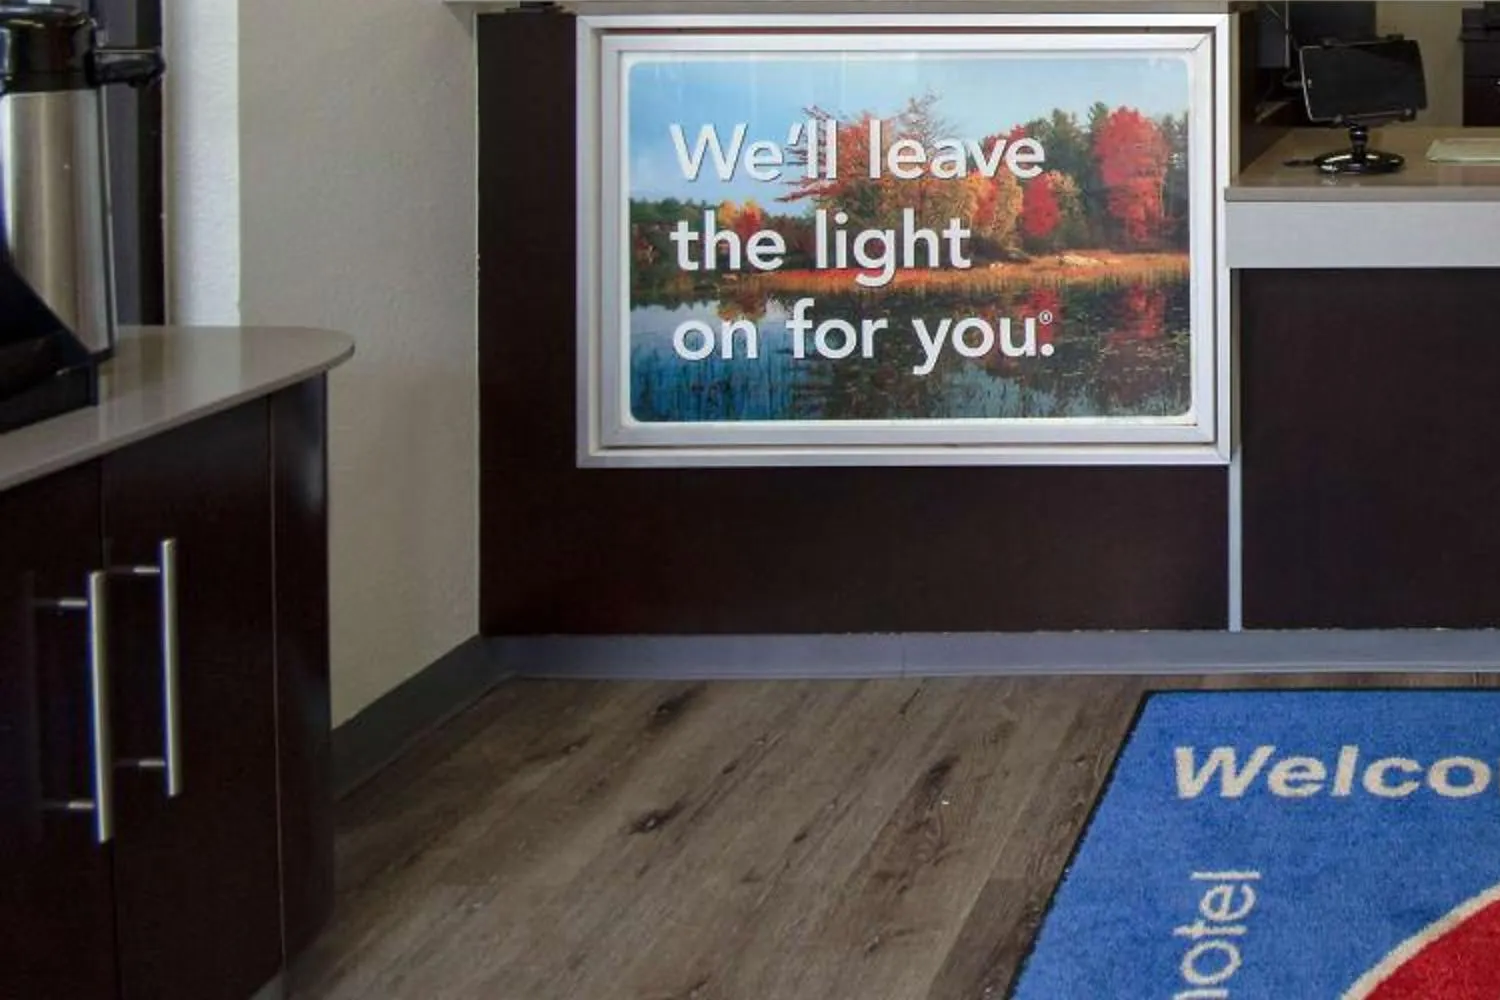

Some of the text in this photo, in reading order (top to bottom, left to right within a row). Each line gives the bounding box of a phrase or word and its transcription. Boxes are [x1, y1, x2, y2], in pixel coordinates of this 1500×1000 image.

[670, 119, 1046, 182] We'll leave
[670, 208, 972, 288] the light
[672, 317, 757, 362] on
[787, 298, 888, 360] for
